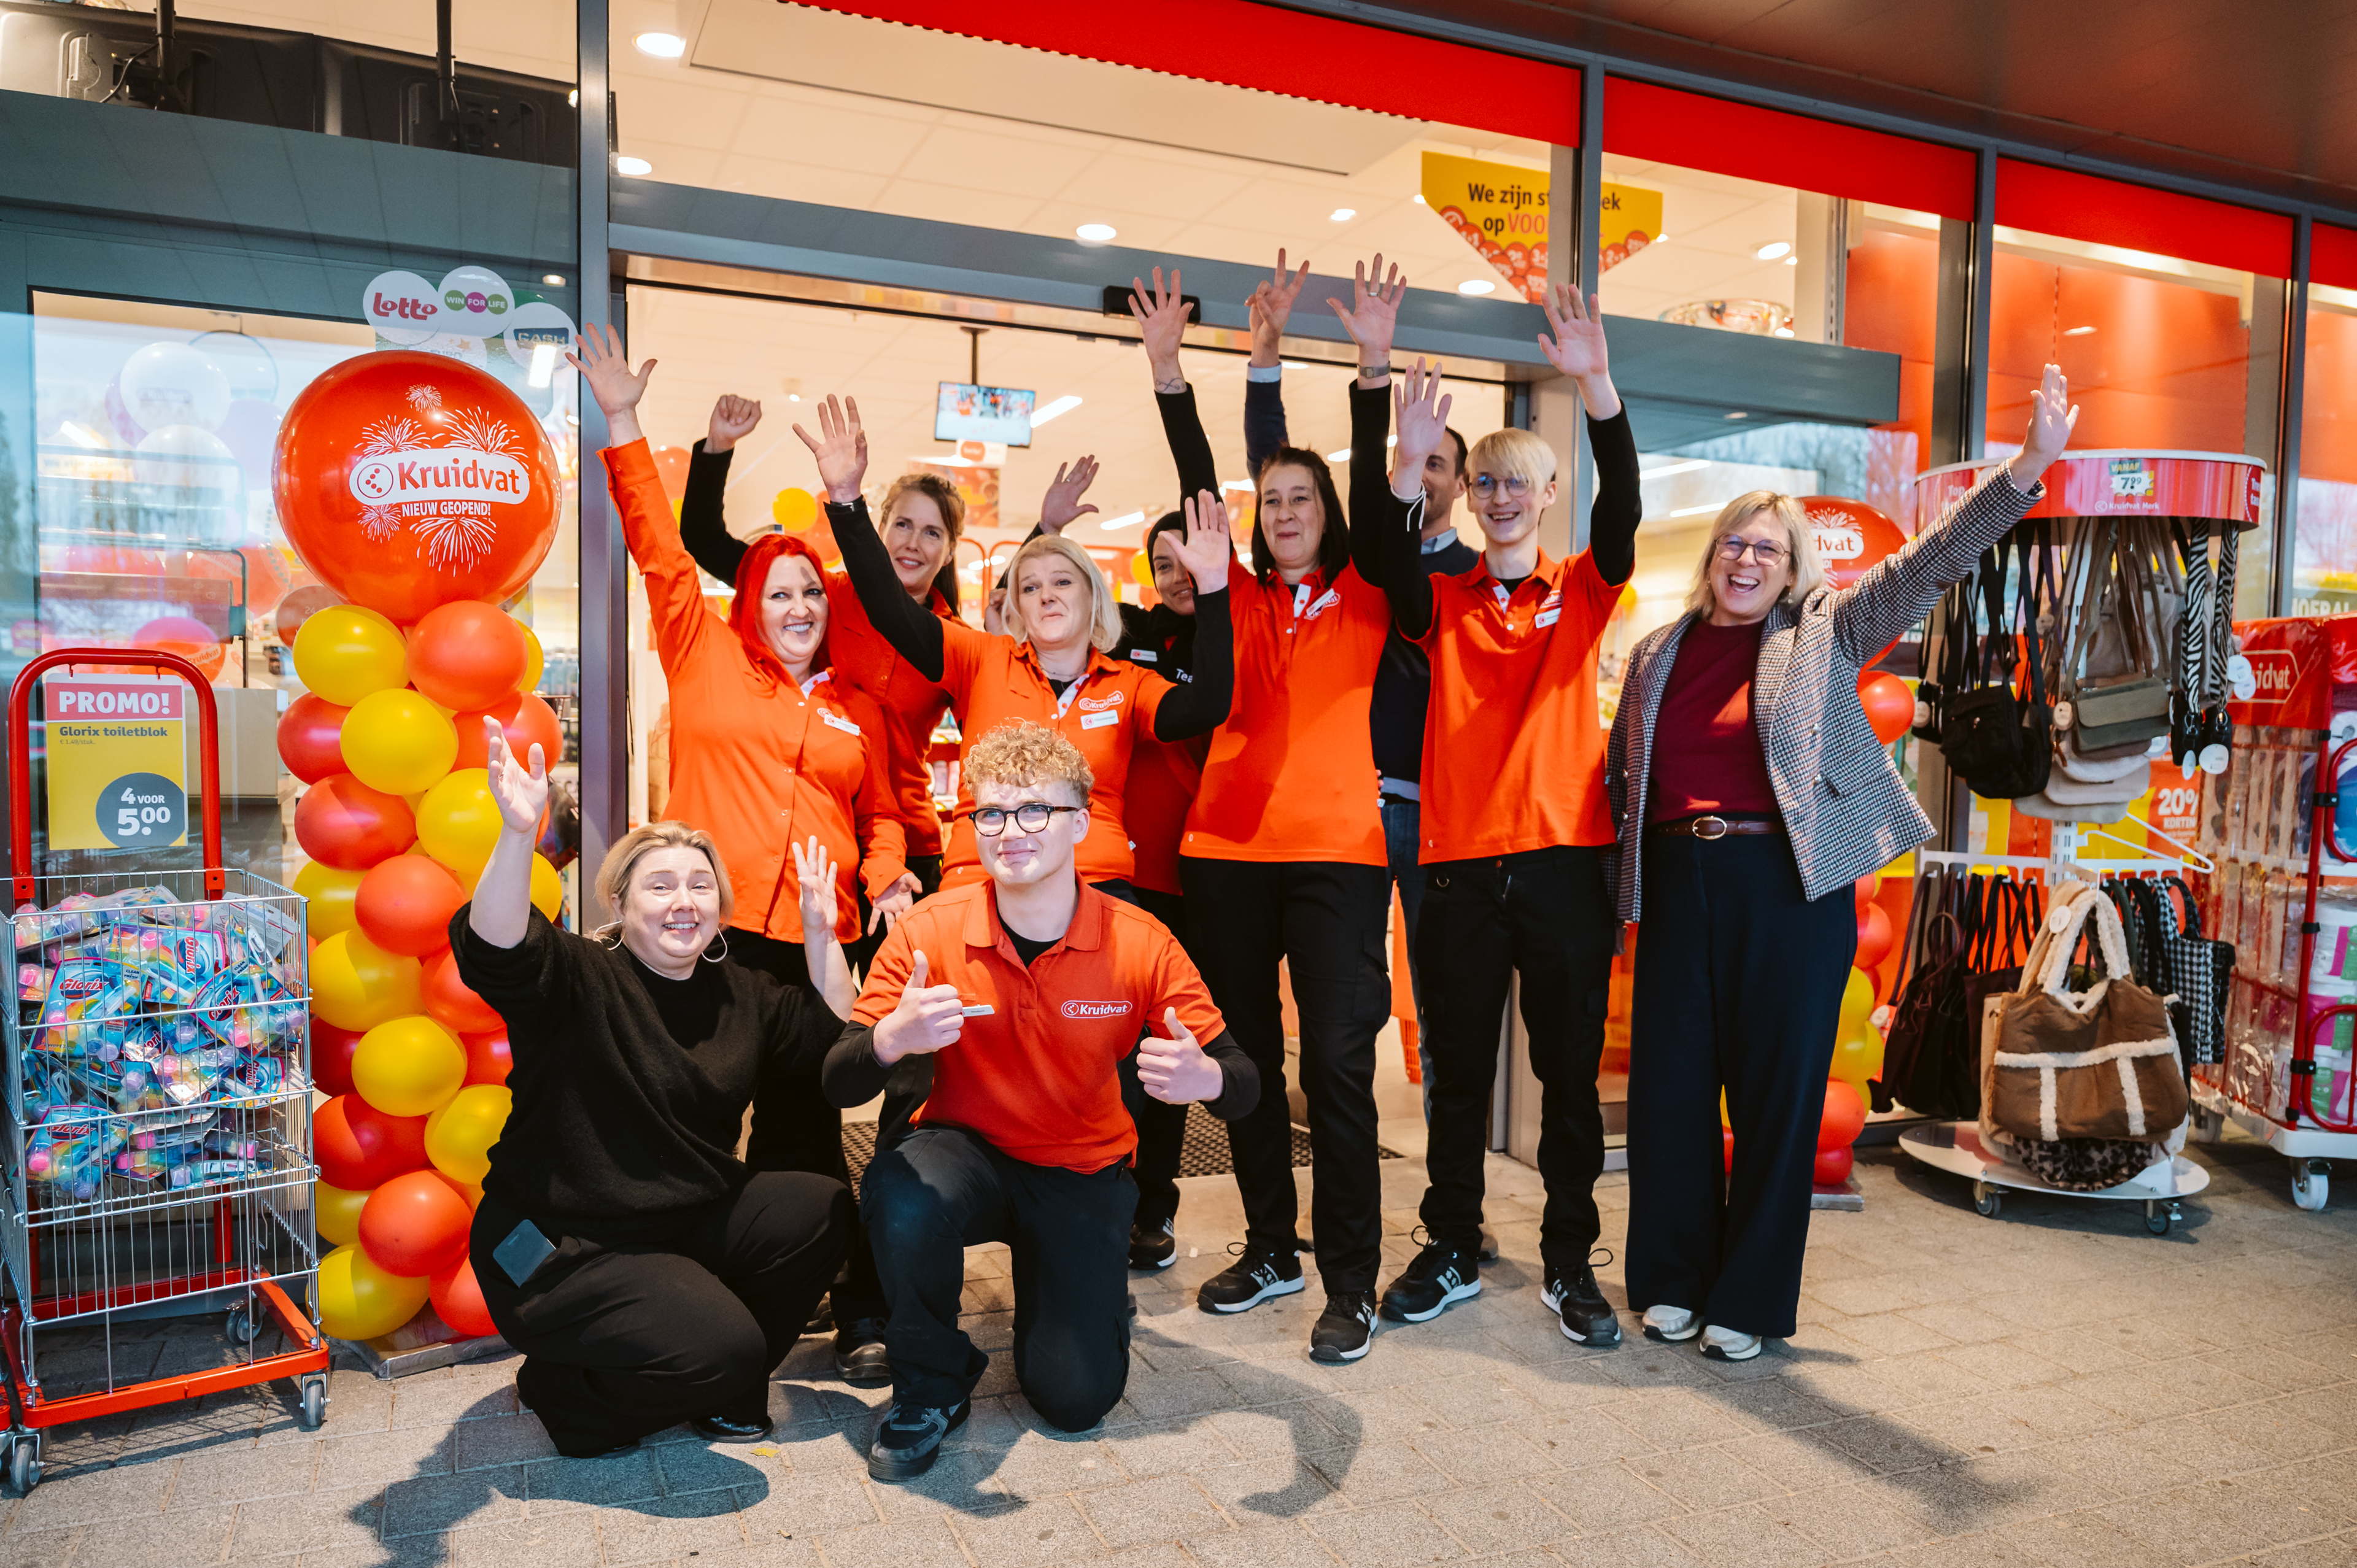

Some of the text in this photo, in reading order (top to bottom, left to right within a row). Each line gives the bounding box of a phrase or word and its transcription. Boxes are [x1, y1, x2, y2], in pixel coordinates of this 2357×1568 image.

[1468, 182, 1495, 203] We
[1500, 185, 1532, 210] zijn
[1483, 217, 1504, 237] op
[373, 292, 438, 320] Lotto
[446, 296, 506, 309] WIN FOR LIFE
[2111, 462, 2140, 473] VANAF
[398, 458, 520, 495] Kruidvat
[402, 500, 491, 517] NIEUW GEOPEND!
[2108, 502, 2140, 511] Kruidvat
[59, 691, 171, 714] PROMO!
[59, 727, 168, 737] Glorix toiletblok
[120, 787, 165, 805] 4 VOOR
[60, 978, 109, 991] Glorix
[1080, 1003, 1128, 1015] Kruidvat
